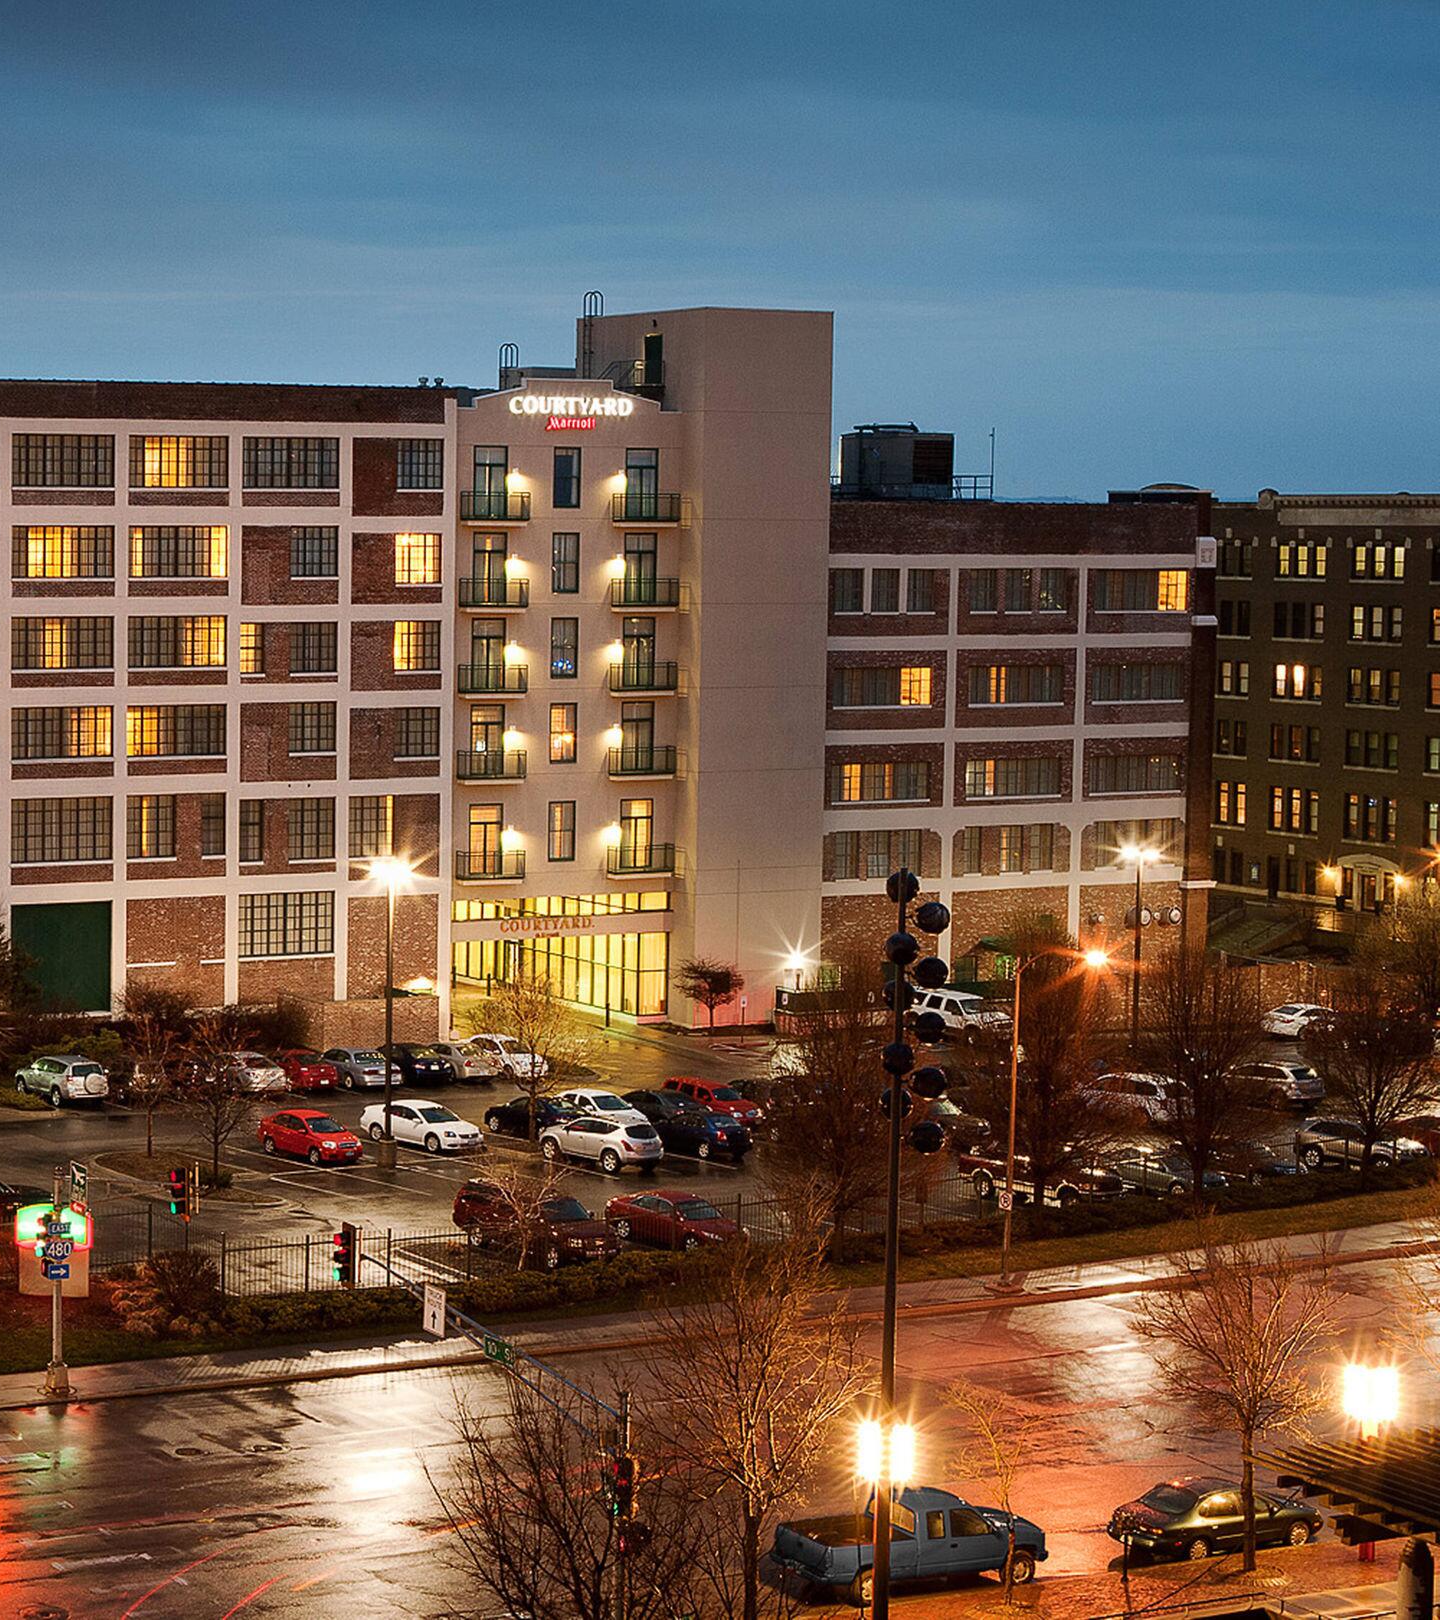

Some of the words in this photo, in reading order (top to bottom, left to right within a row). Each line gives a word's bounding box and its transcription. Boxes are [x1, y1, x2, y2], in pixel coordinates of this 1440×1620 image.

[509, 396, 635, 417] COURTYARD
[545, 416, 596, 431] Marriott
[50, 1223, 70, 1233] EAST
[47, 1242, 71, 1257] 480
